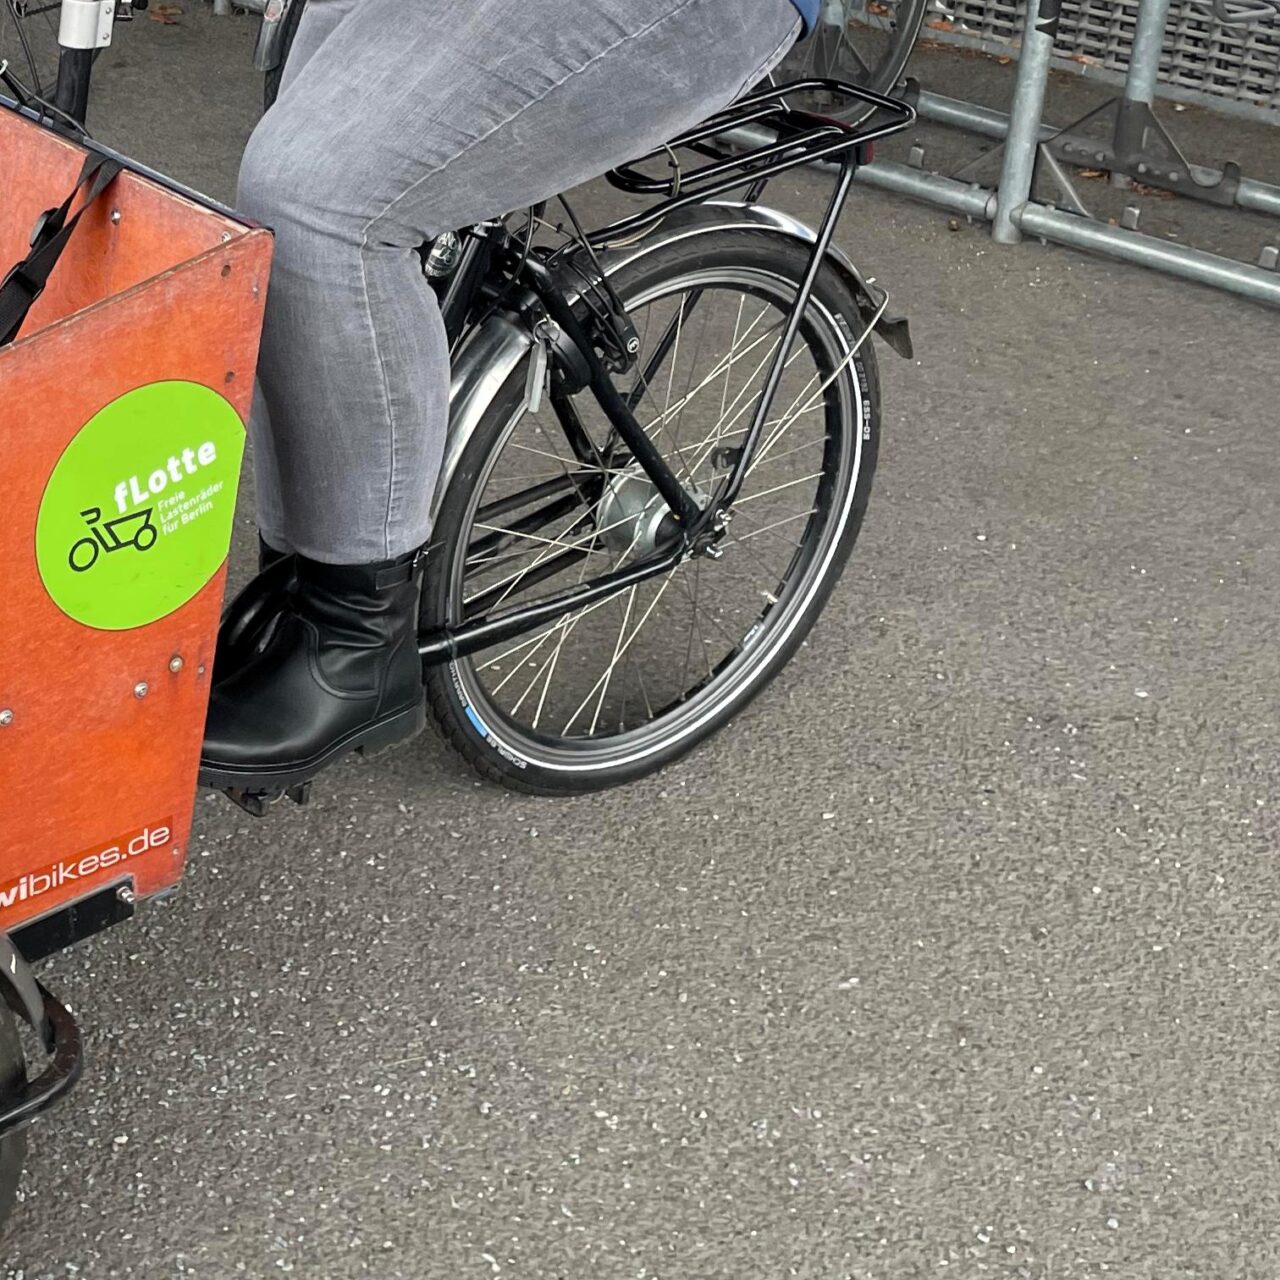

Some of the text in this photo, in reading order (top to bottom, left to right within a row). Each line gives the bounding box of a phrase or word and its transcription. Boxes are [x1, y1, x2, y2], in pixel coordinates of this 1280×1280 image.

[158, 490, 185, 512] Freie
[159, 480, 224, 524] Lastenräder
[162, 500, 214, 537] für Berlin
